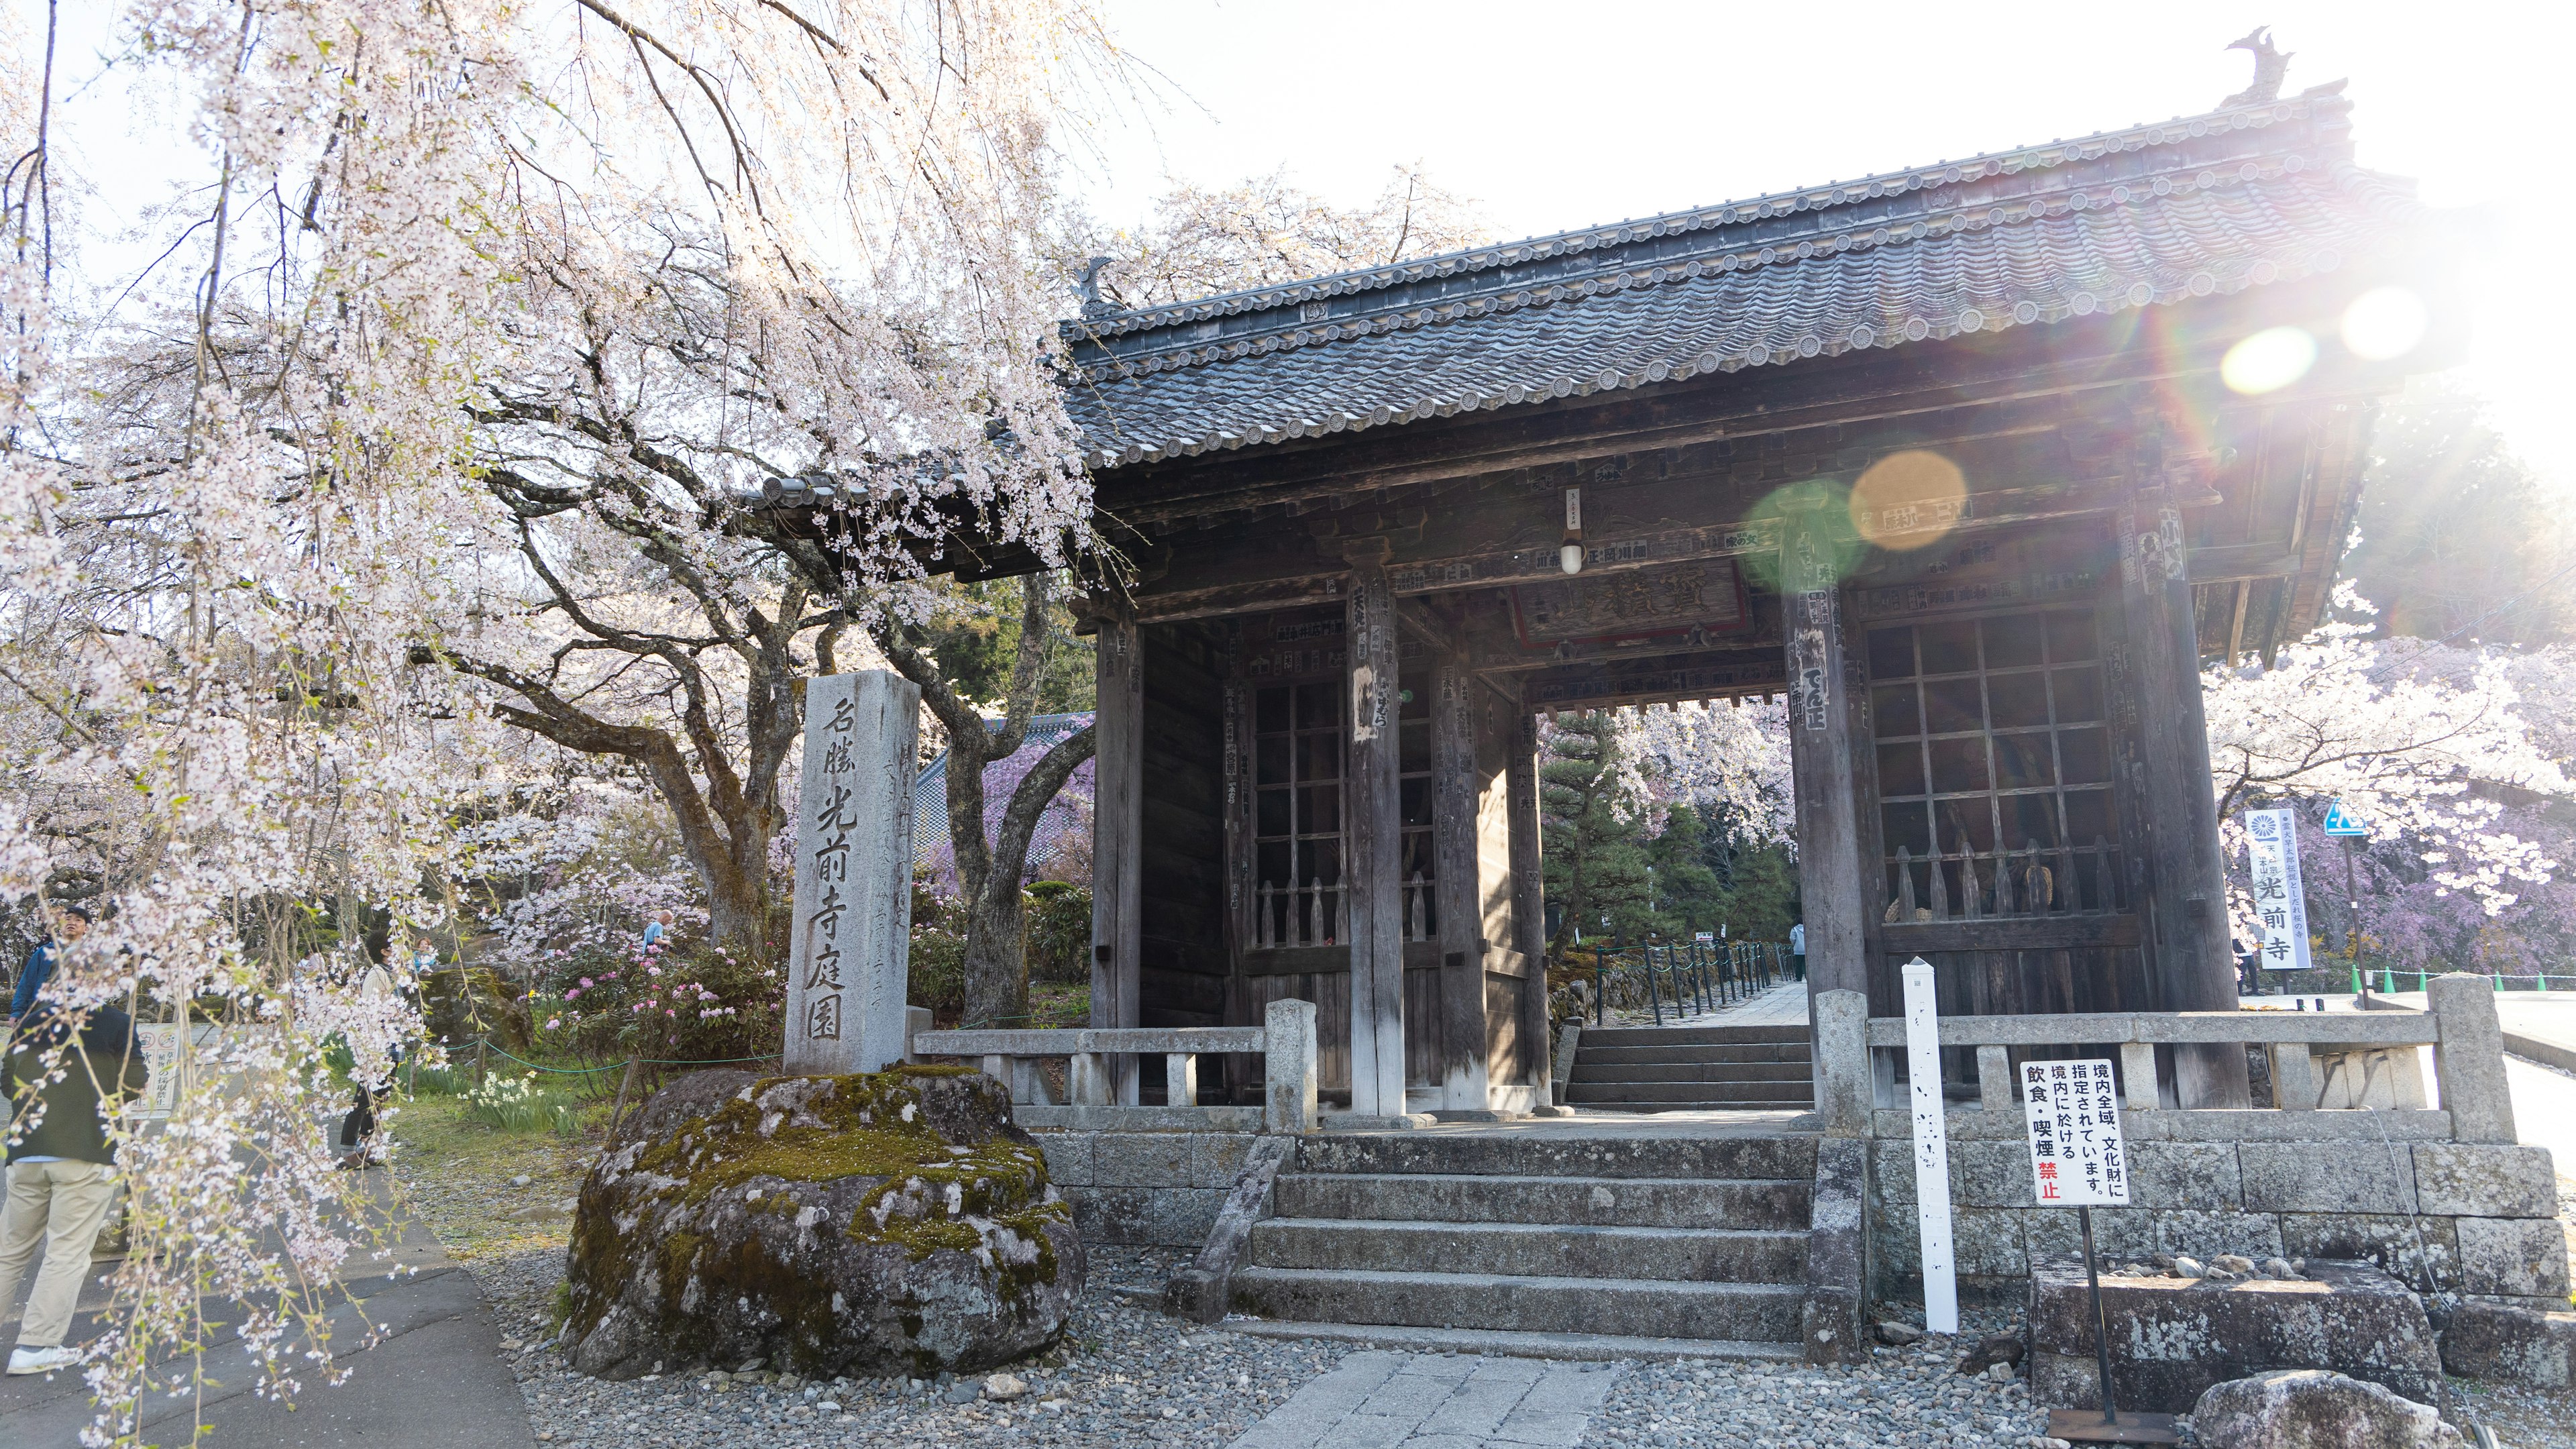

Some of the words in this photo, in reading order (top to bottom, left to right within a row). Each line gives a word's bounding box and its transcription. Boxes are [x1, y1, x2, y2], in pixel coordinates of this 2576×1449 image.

[1804, 669, 1825, 729] でん正
[2259, 876, 2292, 961] 光前寺
[2282, 822, 2303, 938] 霊犬早太郎伝説としだれ桜の寺
[2051, 1065, 2075, 1159] 境内に於ける
[2072, 1065, 2102, 1195] 指定されています。
[2093, 1065, 2123, 1197] 境内全域、文化財に
